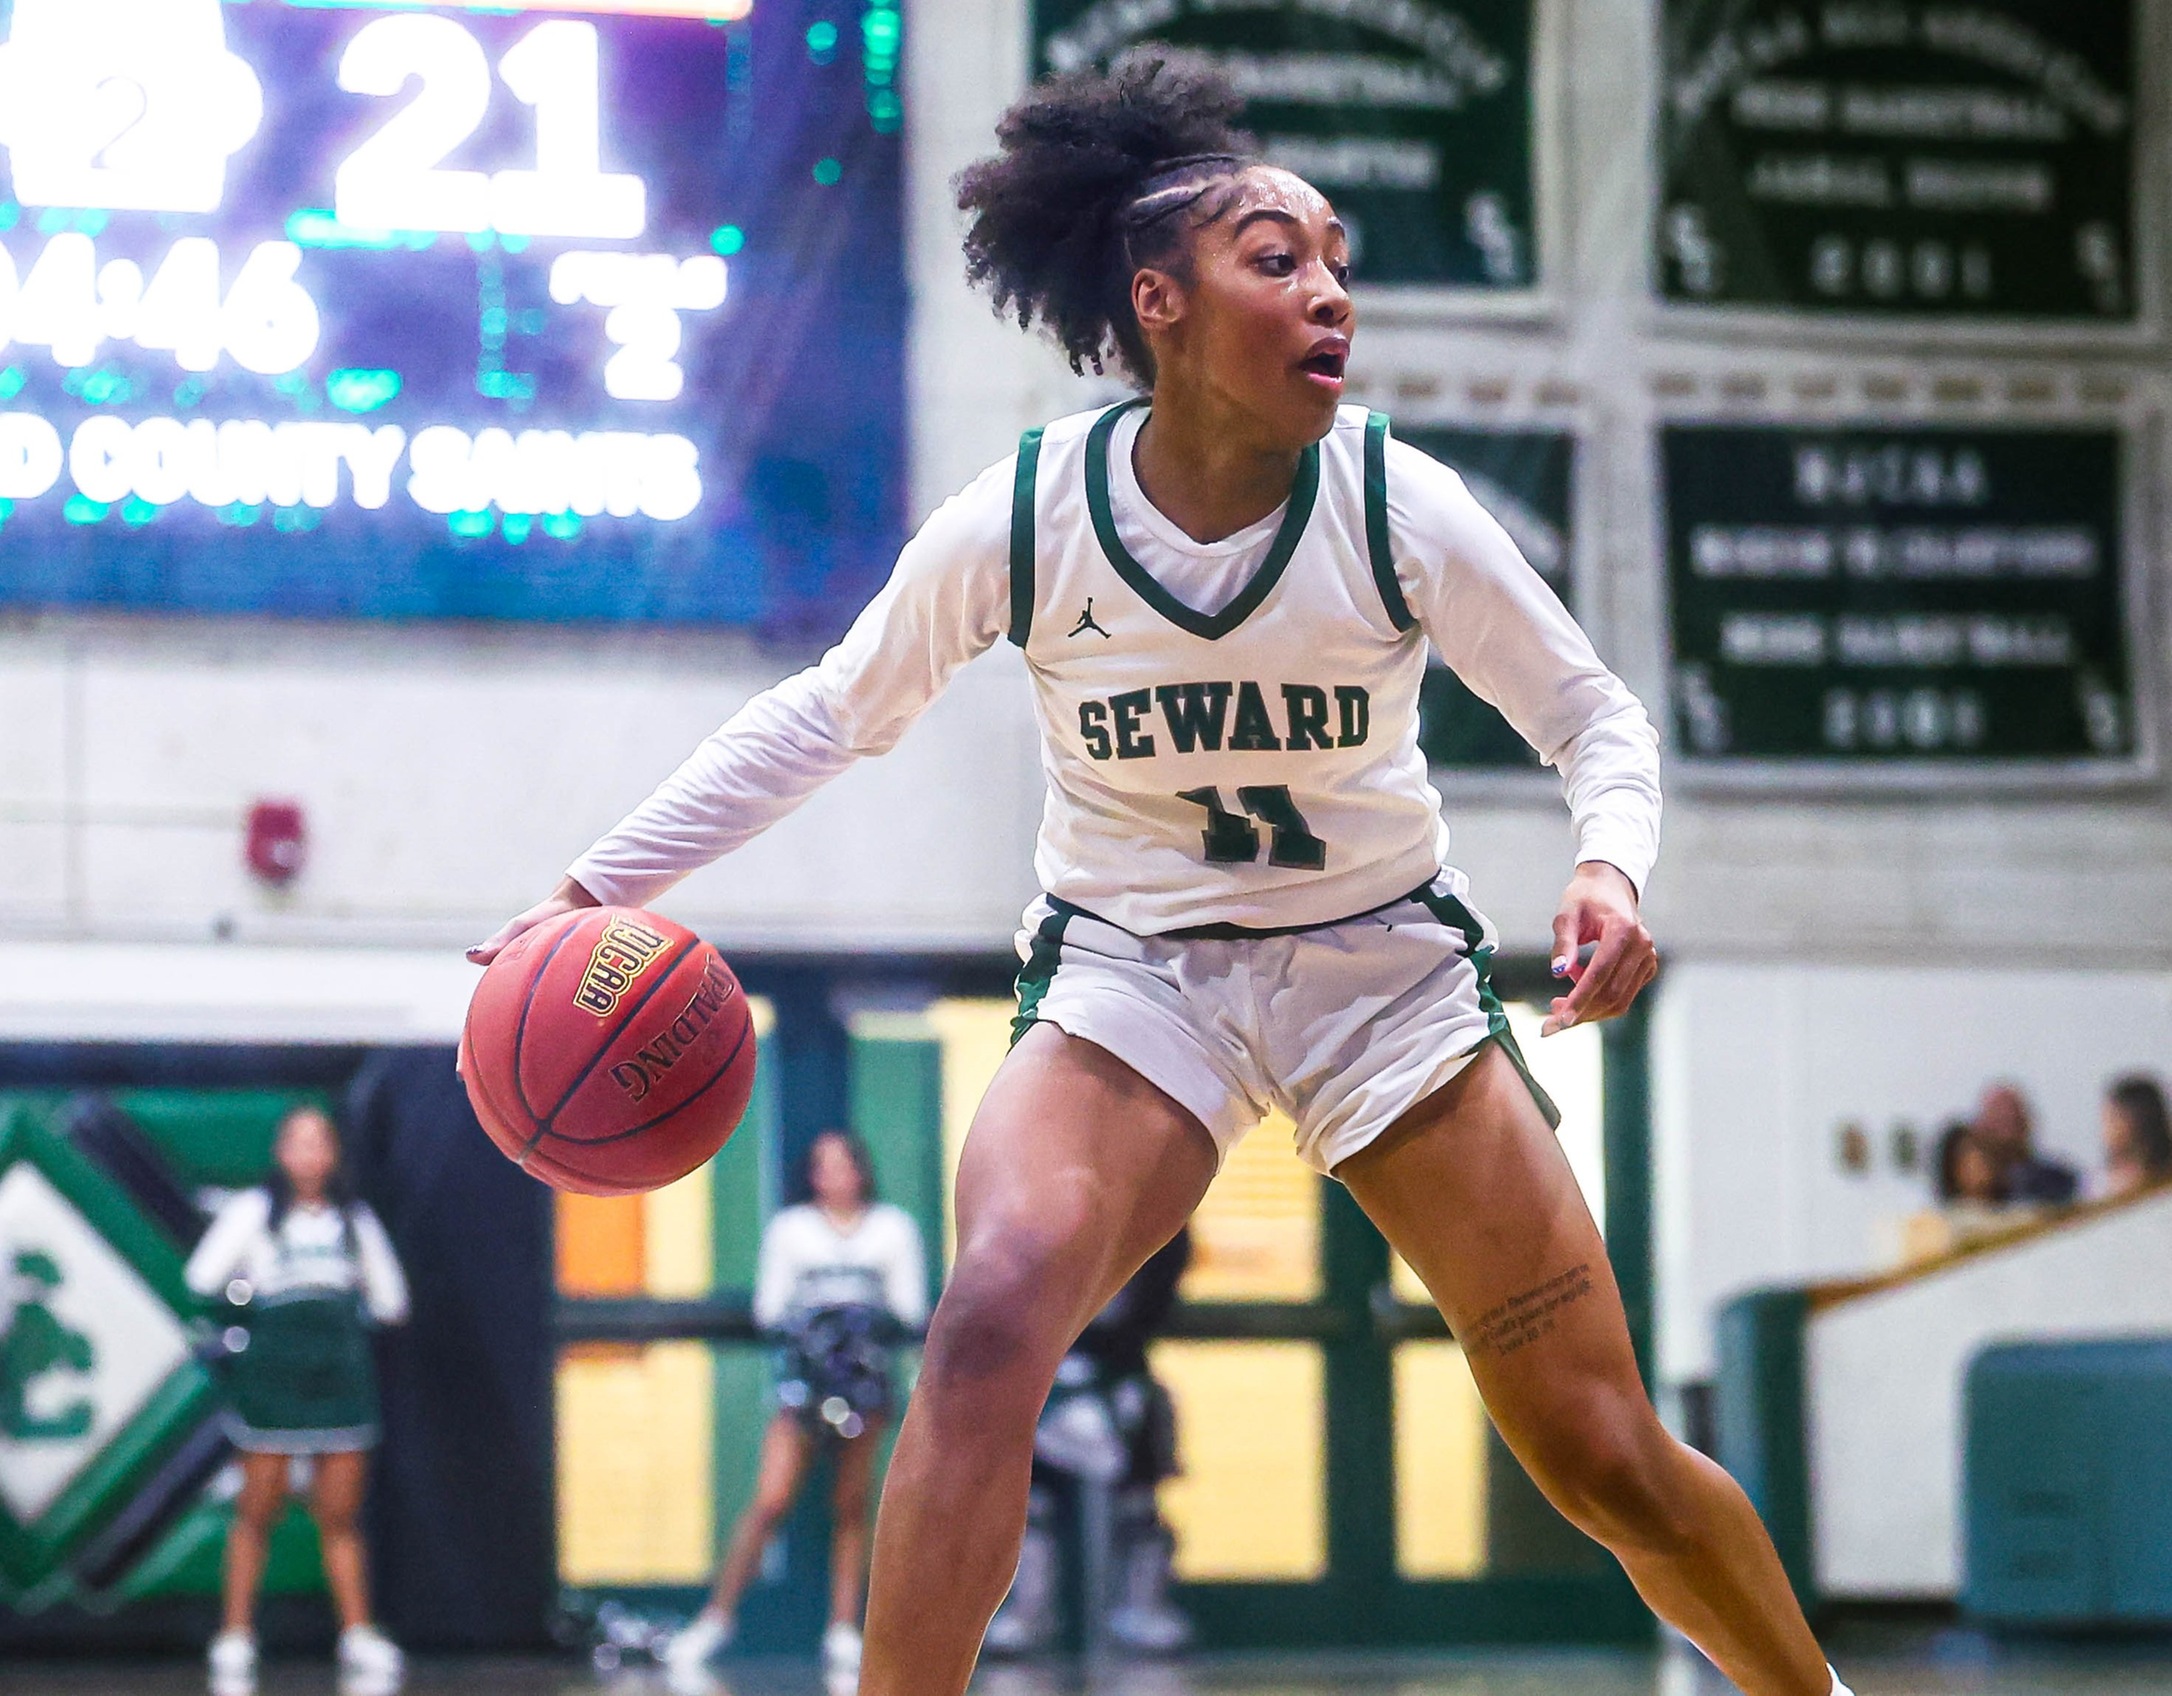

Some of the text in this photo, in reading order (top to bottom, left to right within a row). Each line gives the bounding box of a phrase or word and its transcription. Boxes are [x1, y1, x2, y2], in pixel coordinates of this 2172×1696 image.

[336, 14, 645, 238] 21
[0, 233, 319, 374] 4:46
[70, 416, 404, 509] COUNTY
[1078, 680, 1370, 761] SEWARD
[1175, 783, 1327, 871] 11
